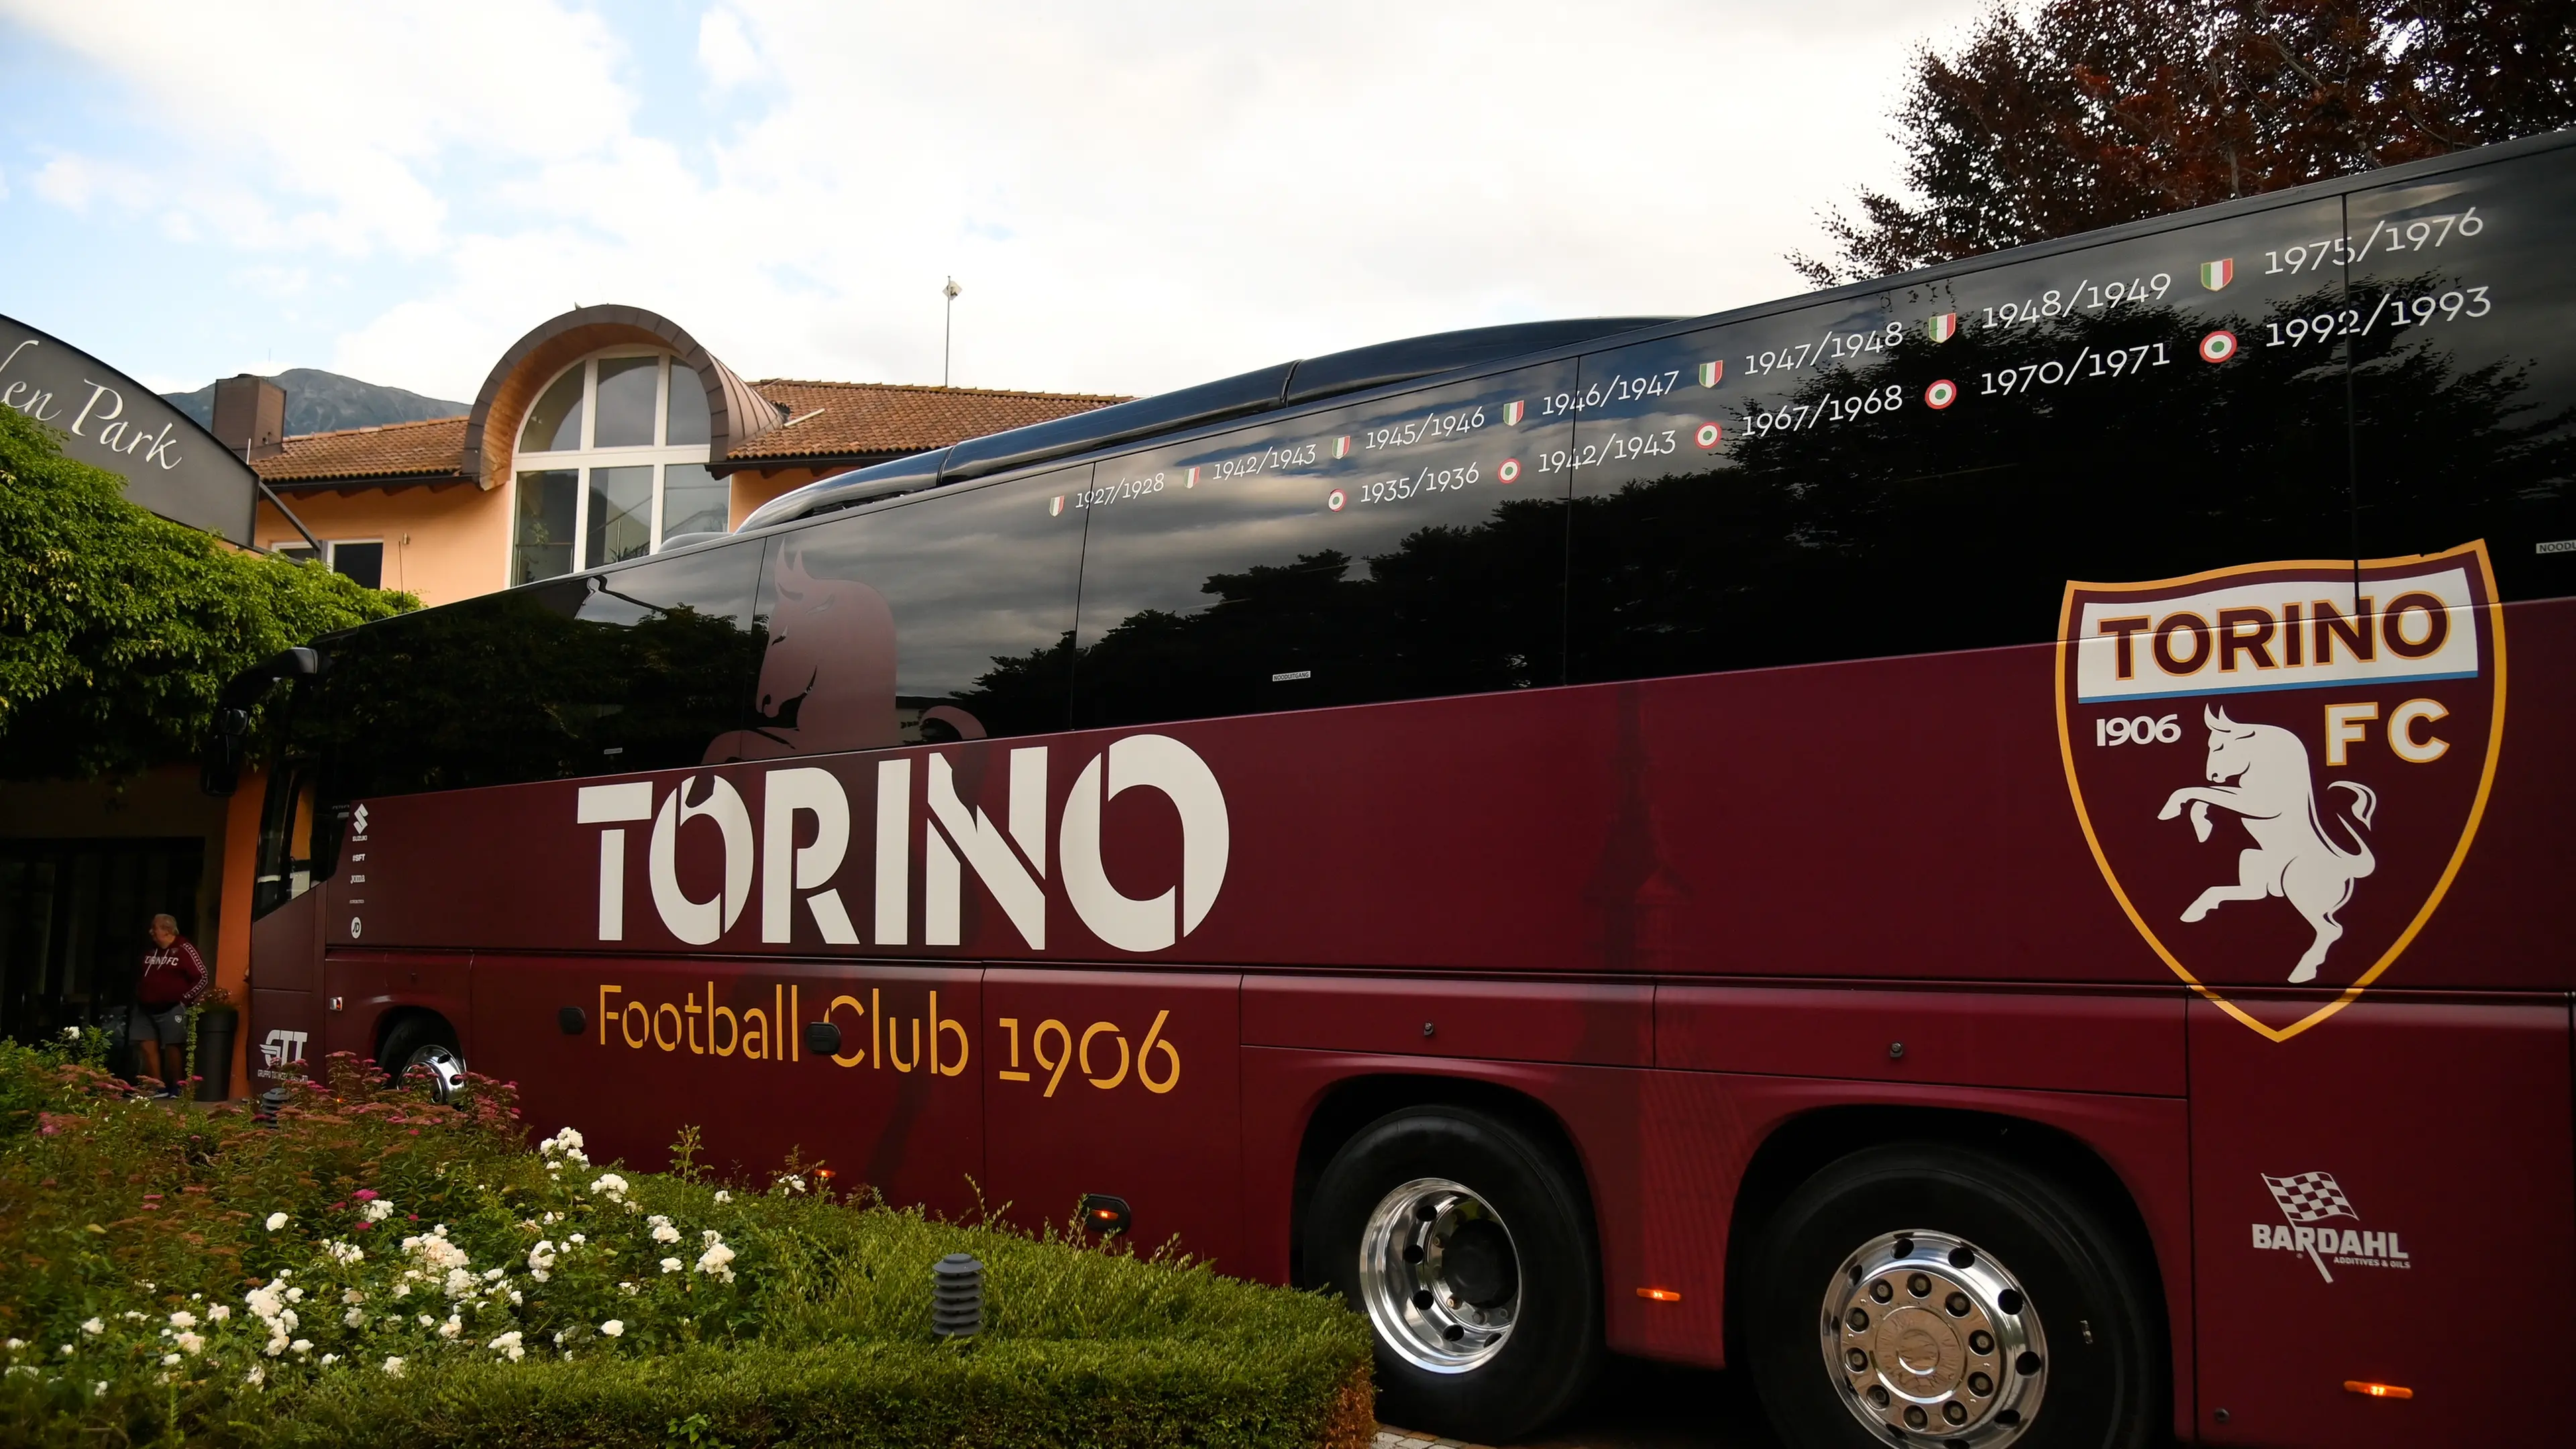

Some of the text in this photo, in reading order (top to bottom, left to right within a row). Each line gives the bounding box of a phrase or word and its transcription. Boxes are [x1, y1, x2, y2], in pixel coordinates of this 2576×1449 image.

[1075, 207, 2483, 509] 1927/1928 1942/1943 1945/1946 1946/1947 1947/1948 1948/1949 1975/1976
[1360, 286, 2491, 504] 1935/1936 1942/1943 1967/1968 1970/1971 1992/1993
[72, 378, 182, 470] Park
[2098, 590, 2451, 680] TORINO
[1273, 672, 1309, 681] NOODUITGANG
[2096, 714, 2182, 747] 1906
[2324, 698, 2449, 766] FC
[577, 734, 1230, 952] TORINO
[259, 1029, 308, 1068] GTT
[600, 981, 1180, 1097] Football Club 1906
[2252, 1224, 2409, 1260] BARDAHL
[2333, 1256, 2379, 1266] ADDITIVES
[2390, 1260, 2411, 1269] OILS
